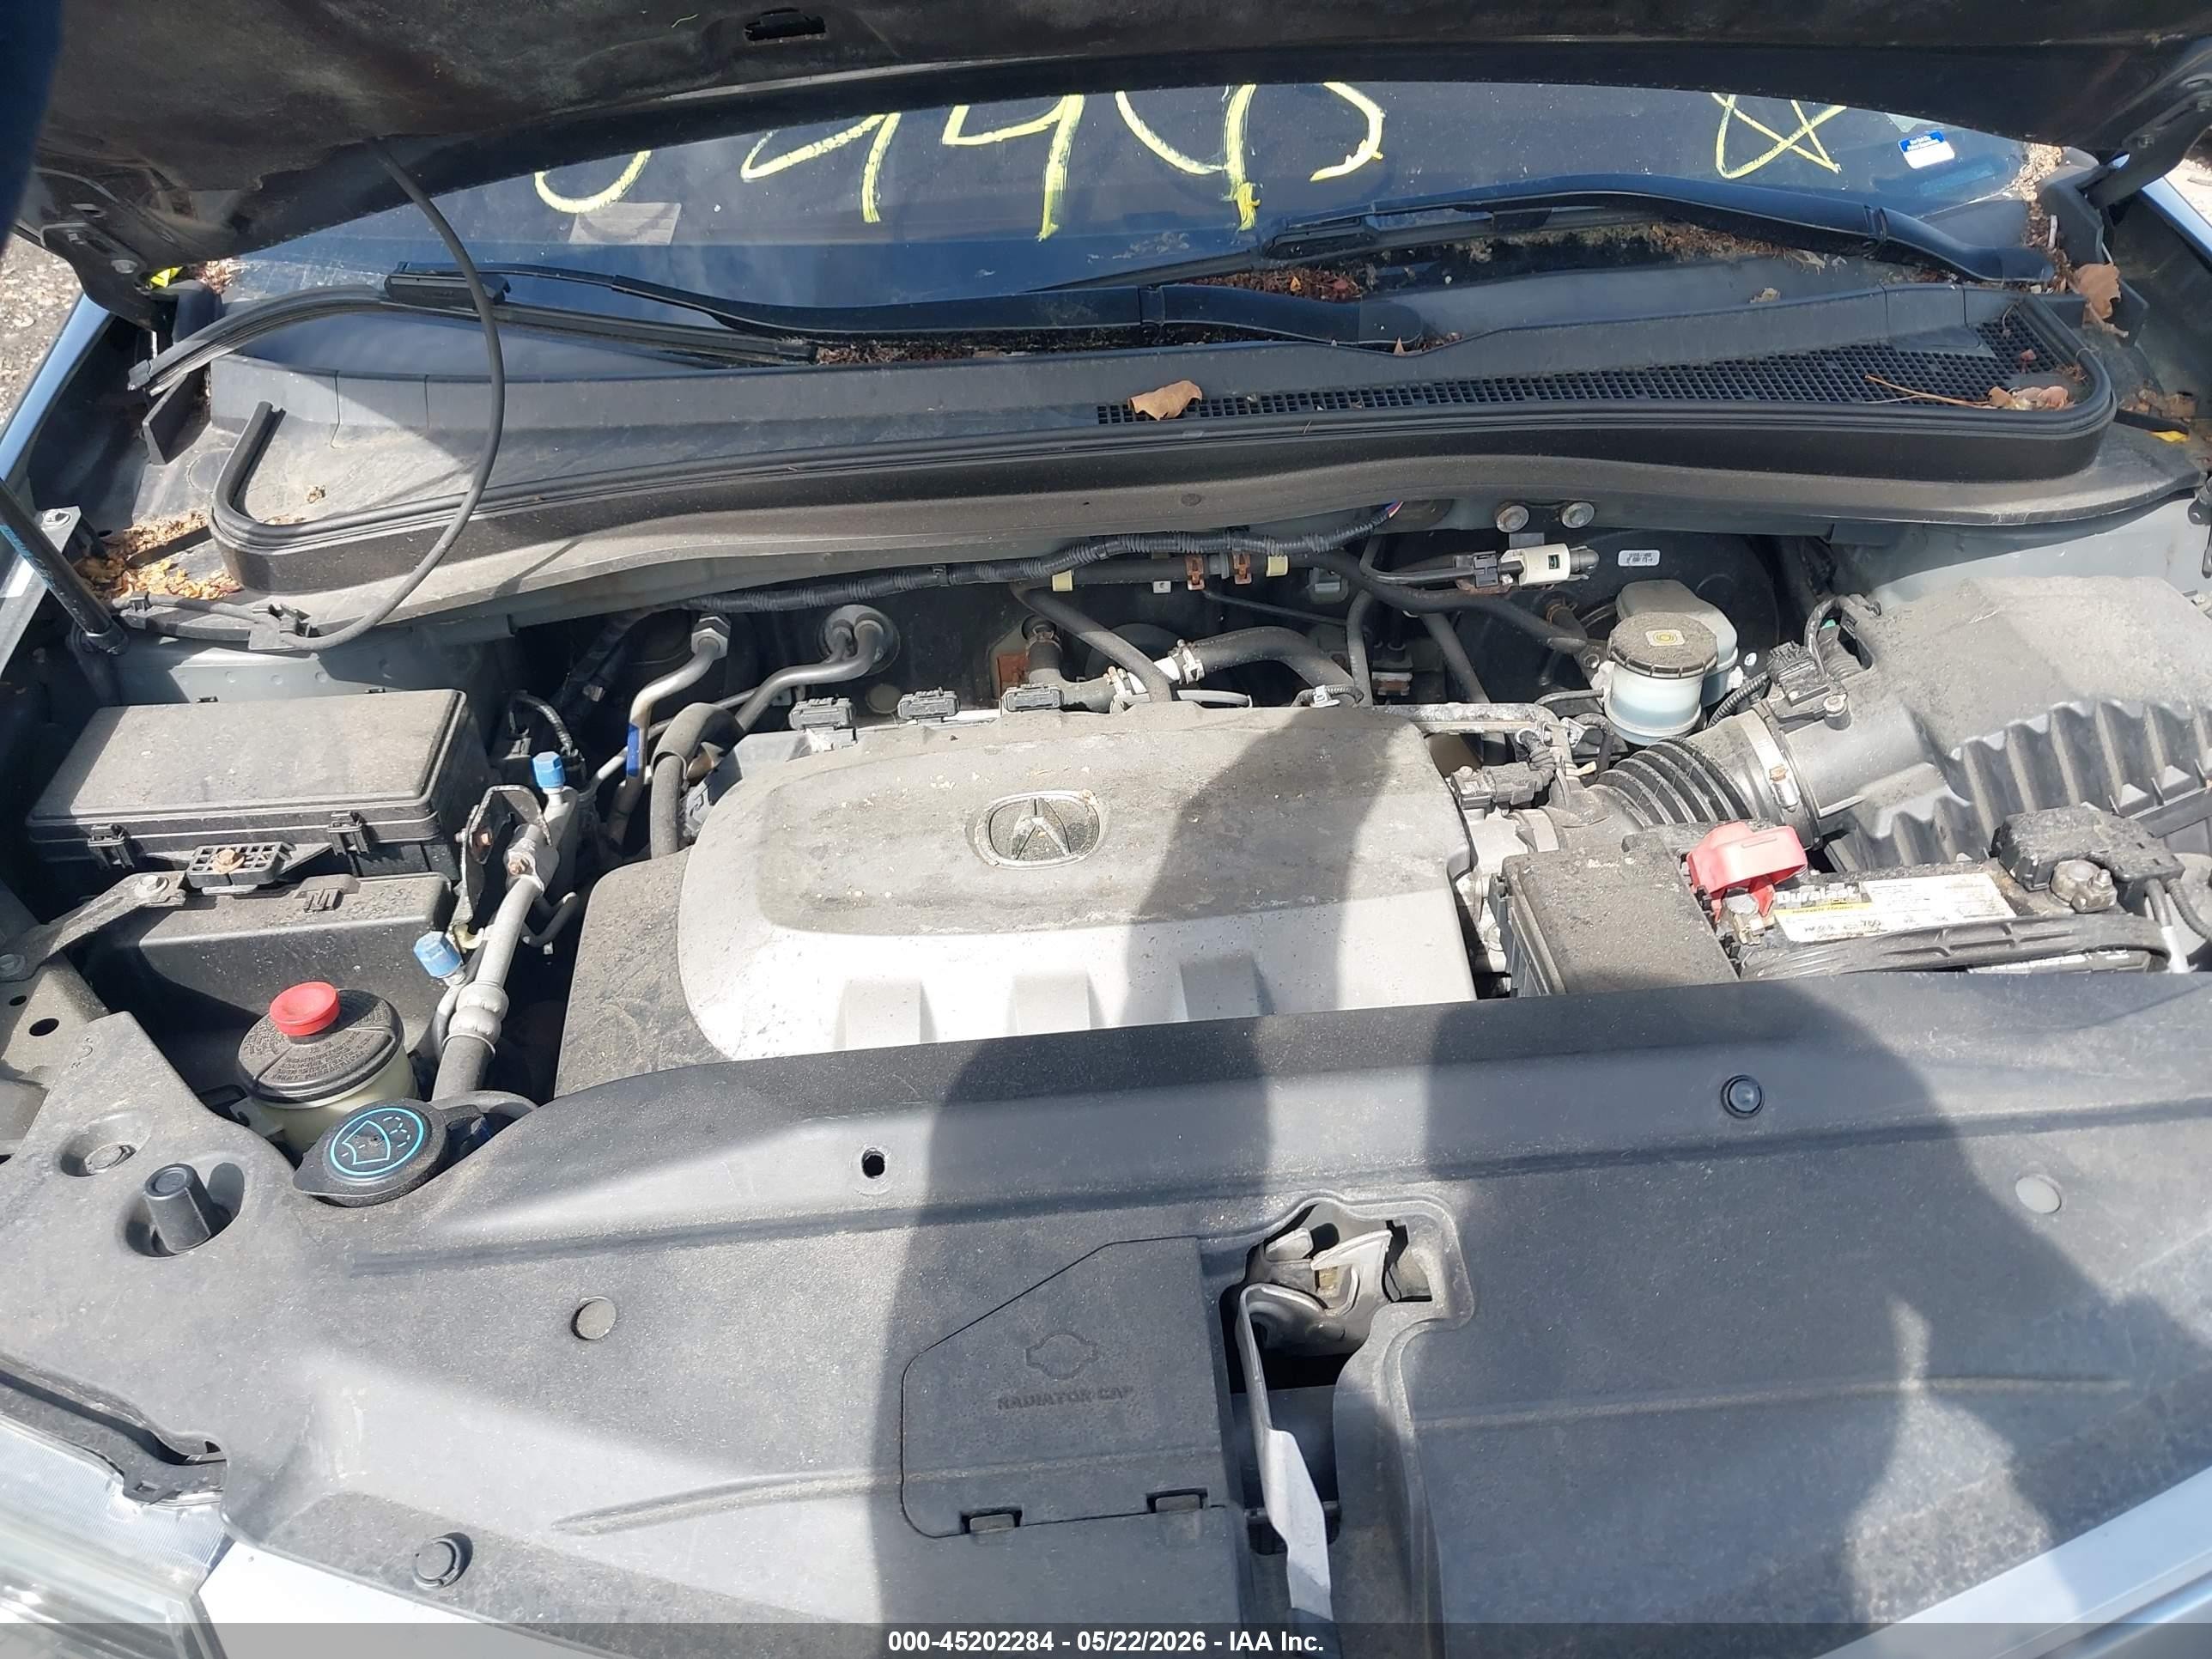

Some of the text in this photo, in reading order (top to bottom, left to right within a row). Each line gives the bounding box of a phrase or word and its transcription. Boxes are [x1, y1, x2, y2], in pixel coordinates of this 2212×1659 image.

[1776, 884, 1856, 904] Duralast
[997, 1385, 1133, 1410] RADIATOR CAP
